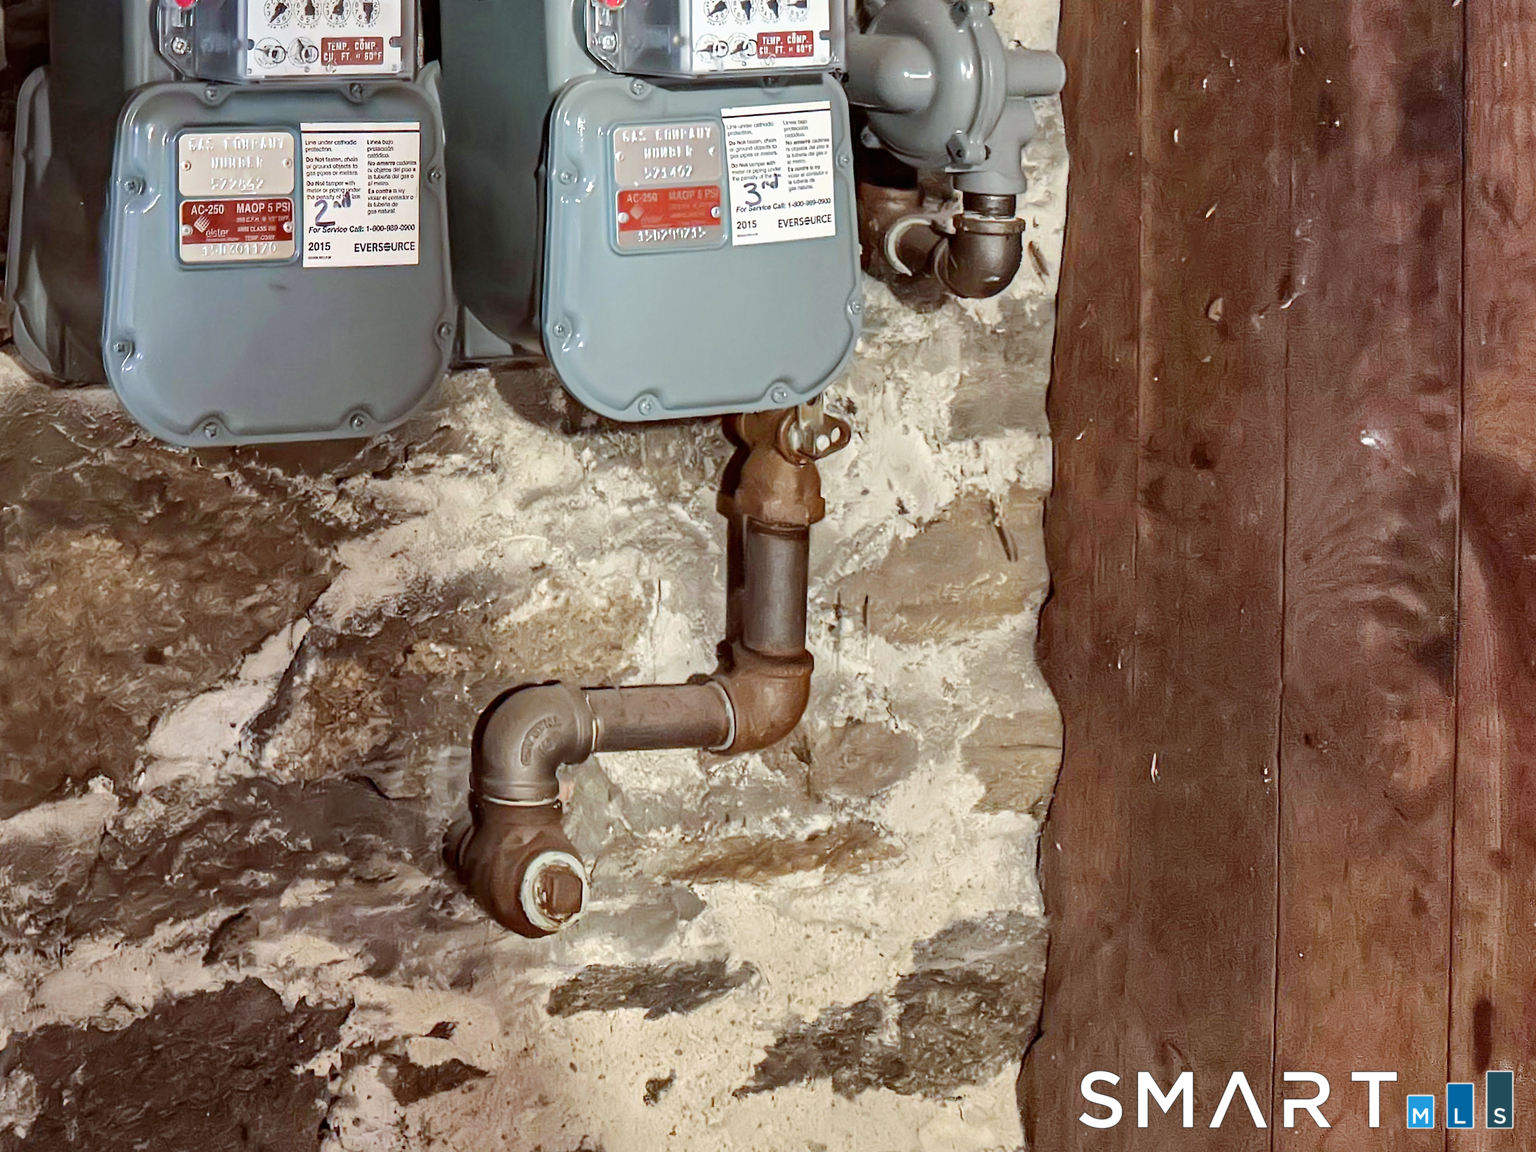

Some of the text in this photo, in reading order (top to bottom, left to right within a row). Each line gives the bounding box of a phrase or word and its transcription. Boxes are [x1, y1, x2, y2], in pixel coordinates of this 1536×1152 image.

[327, 41, 349, 50] TEMP.
[743, 173, 779, 207] 3rd
[627, 192, 658, 203] AC-250
[191, 204, 224, 215] AC-250
[236, 201, 291, 214] MAOP 5 PSI
[748, 204, 771, 212] Service
[736, 214, 832, 229] 2015 EVERSOURCE
[206, 228, 229, 238] elster
[322, 226, 347, 234] Service
[308, 241, 415, 253] 2015 EVERSOURCE
